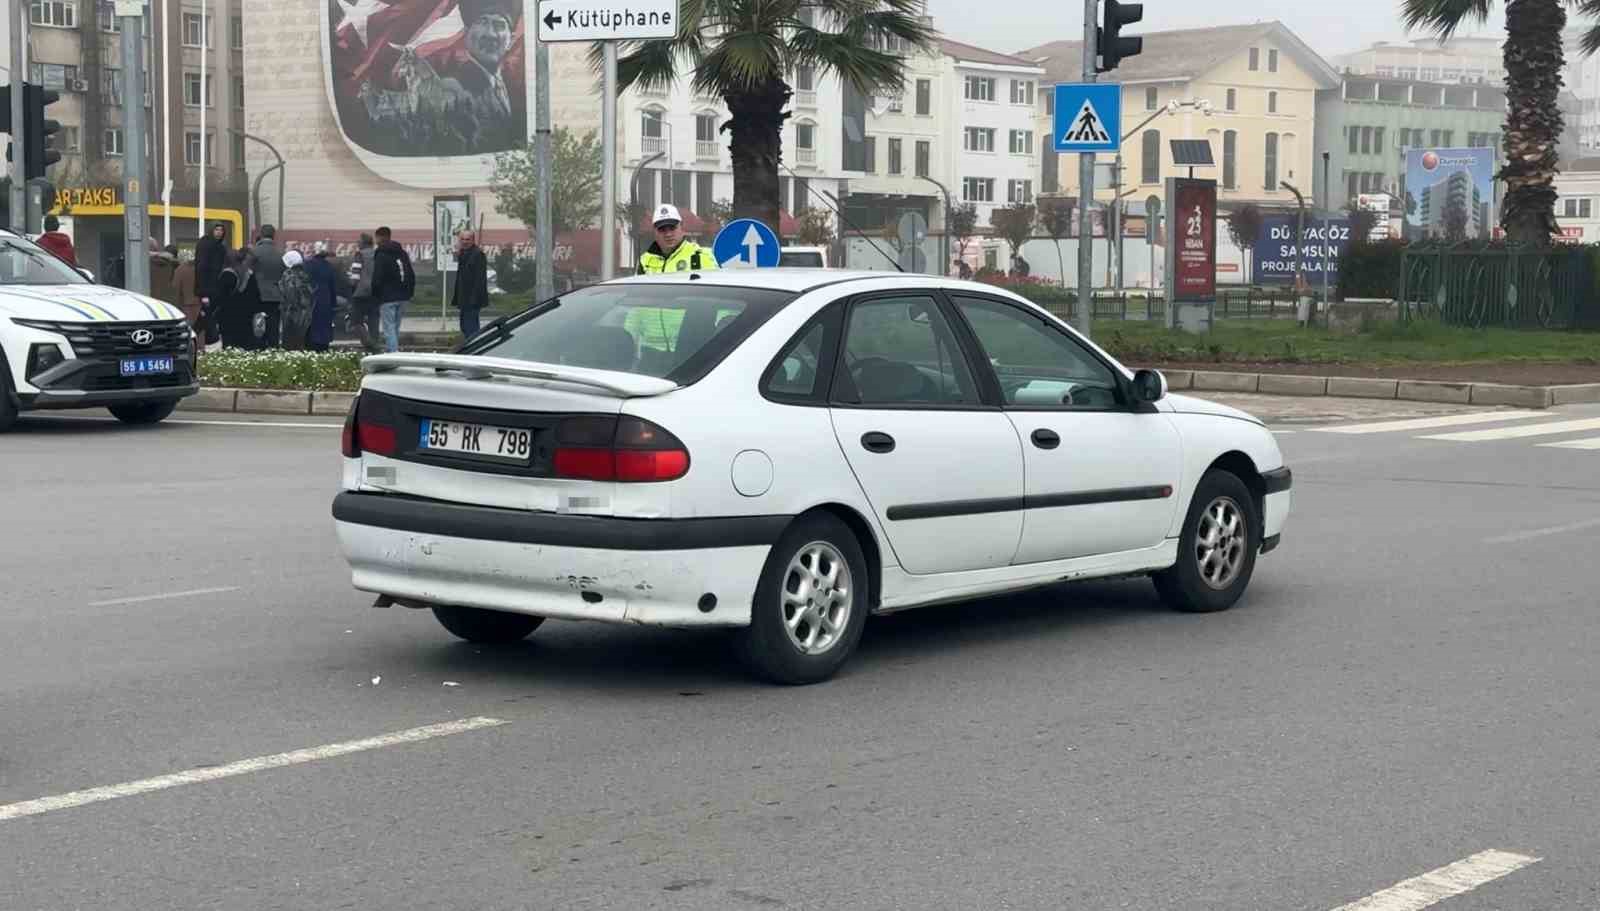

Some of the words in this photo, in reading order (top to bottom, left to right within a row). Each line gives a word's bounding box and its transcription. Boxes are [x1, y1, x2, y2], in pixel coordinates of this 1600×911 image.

[567, 8, 671, 32] Kütüphane
[1271, 224, 1350, 240] DÜYAGÖZ
[1280, 245, 1338, 257] SAMSUN
[1262, 261, 1296, 272] PROJE
[124, 360, 135, 371] 55
[139, 361, 145, 371] A
[148, 360, 170, 370] 5454
[430, 422, 449, 448] 55
[461, 425, 482, 451] RK
[497, 428, 528, 455] 798
